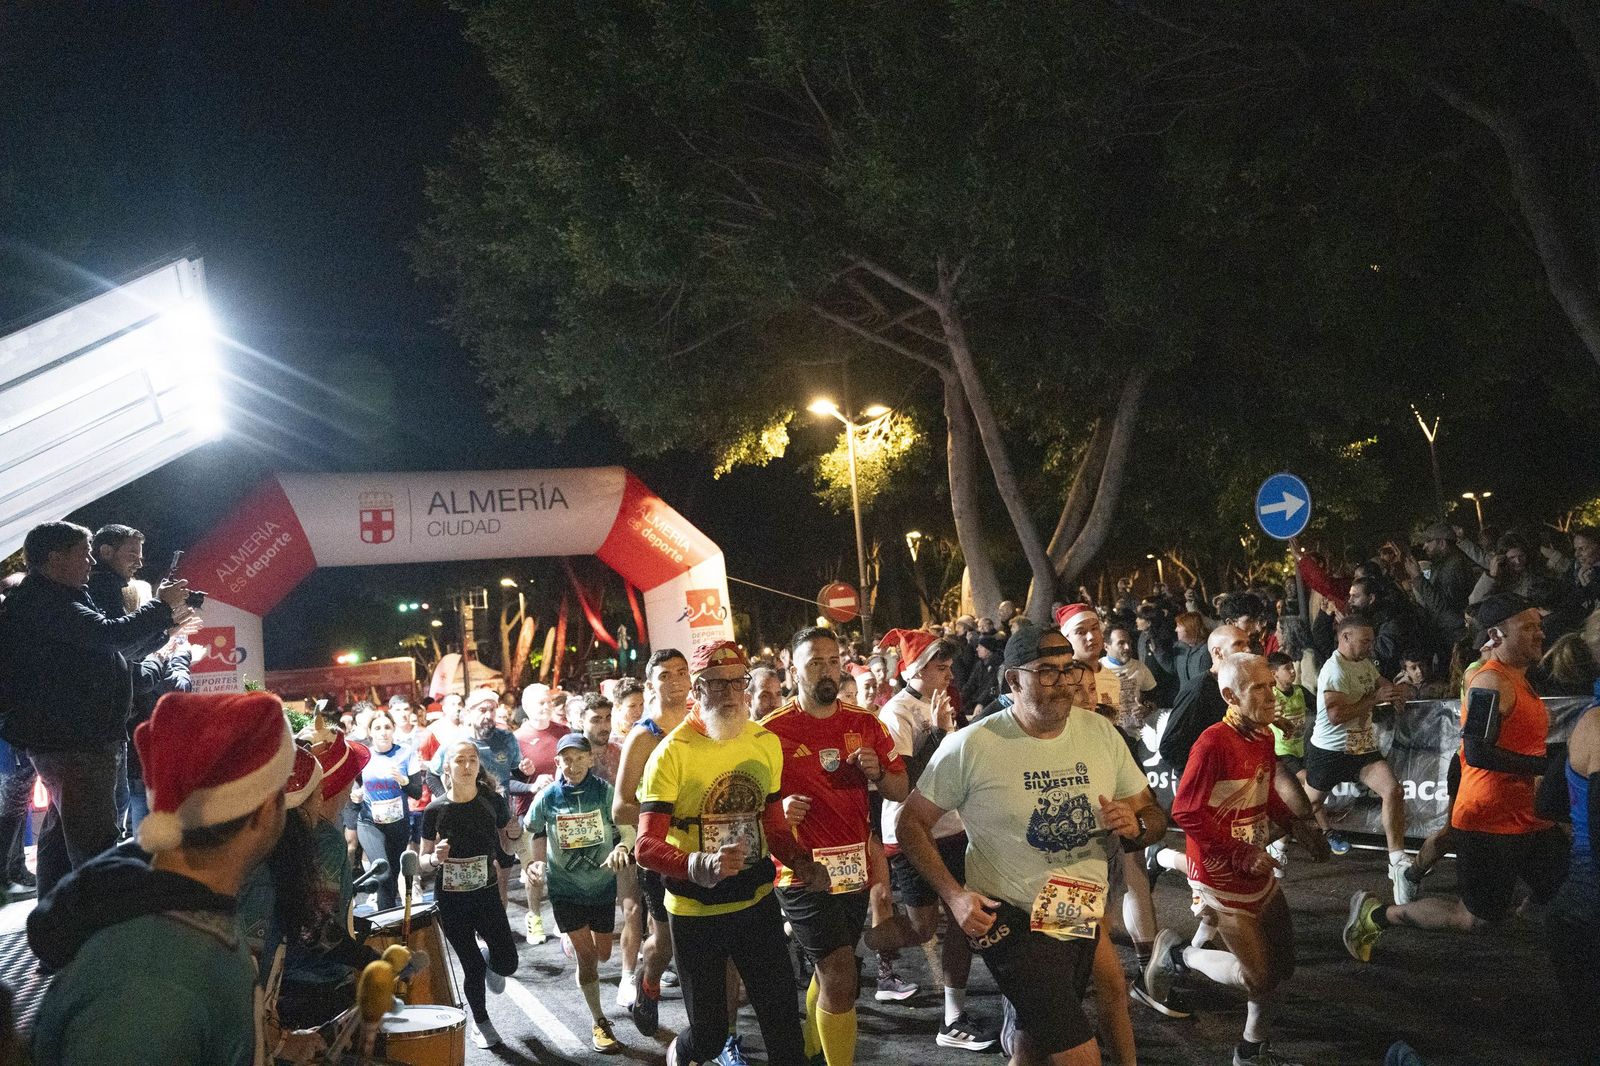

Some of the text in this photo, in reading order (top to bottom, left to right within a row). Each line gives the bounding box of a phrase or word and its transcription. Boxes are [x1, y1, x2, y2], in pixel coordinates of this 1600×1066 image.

[427, 482, 569, 515] ALMERÍA
[427, 518, 501, 537] CIUDAD
[627, 516, 684, 564] es deporte
[230, 532, 292, 593] es deporte
[1023, 770, 1051, 781] SAN
[1024, 775, 1090, 791] SILVESTRE
[568, 826, 594, 837] 2397
[453, 870, 478, 880] 1682
[830, 863, 858, 877] 2308
